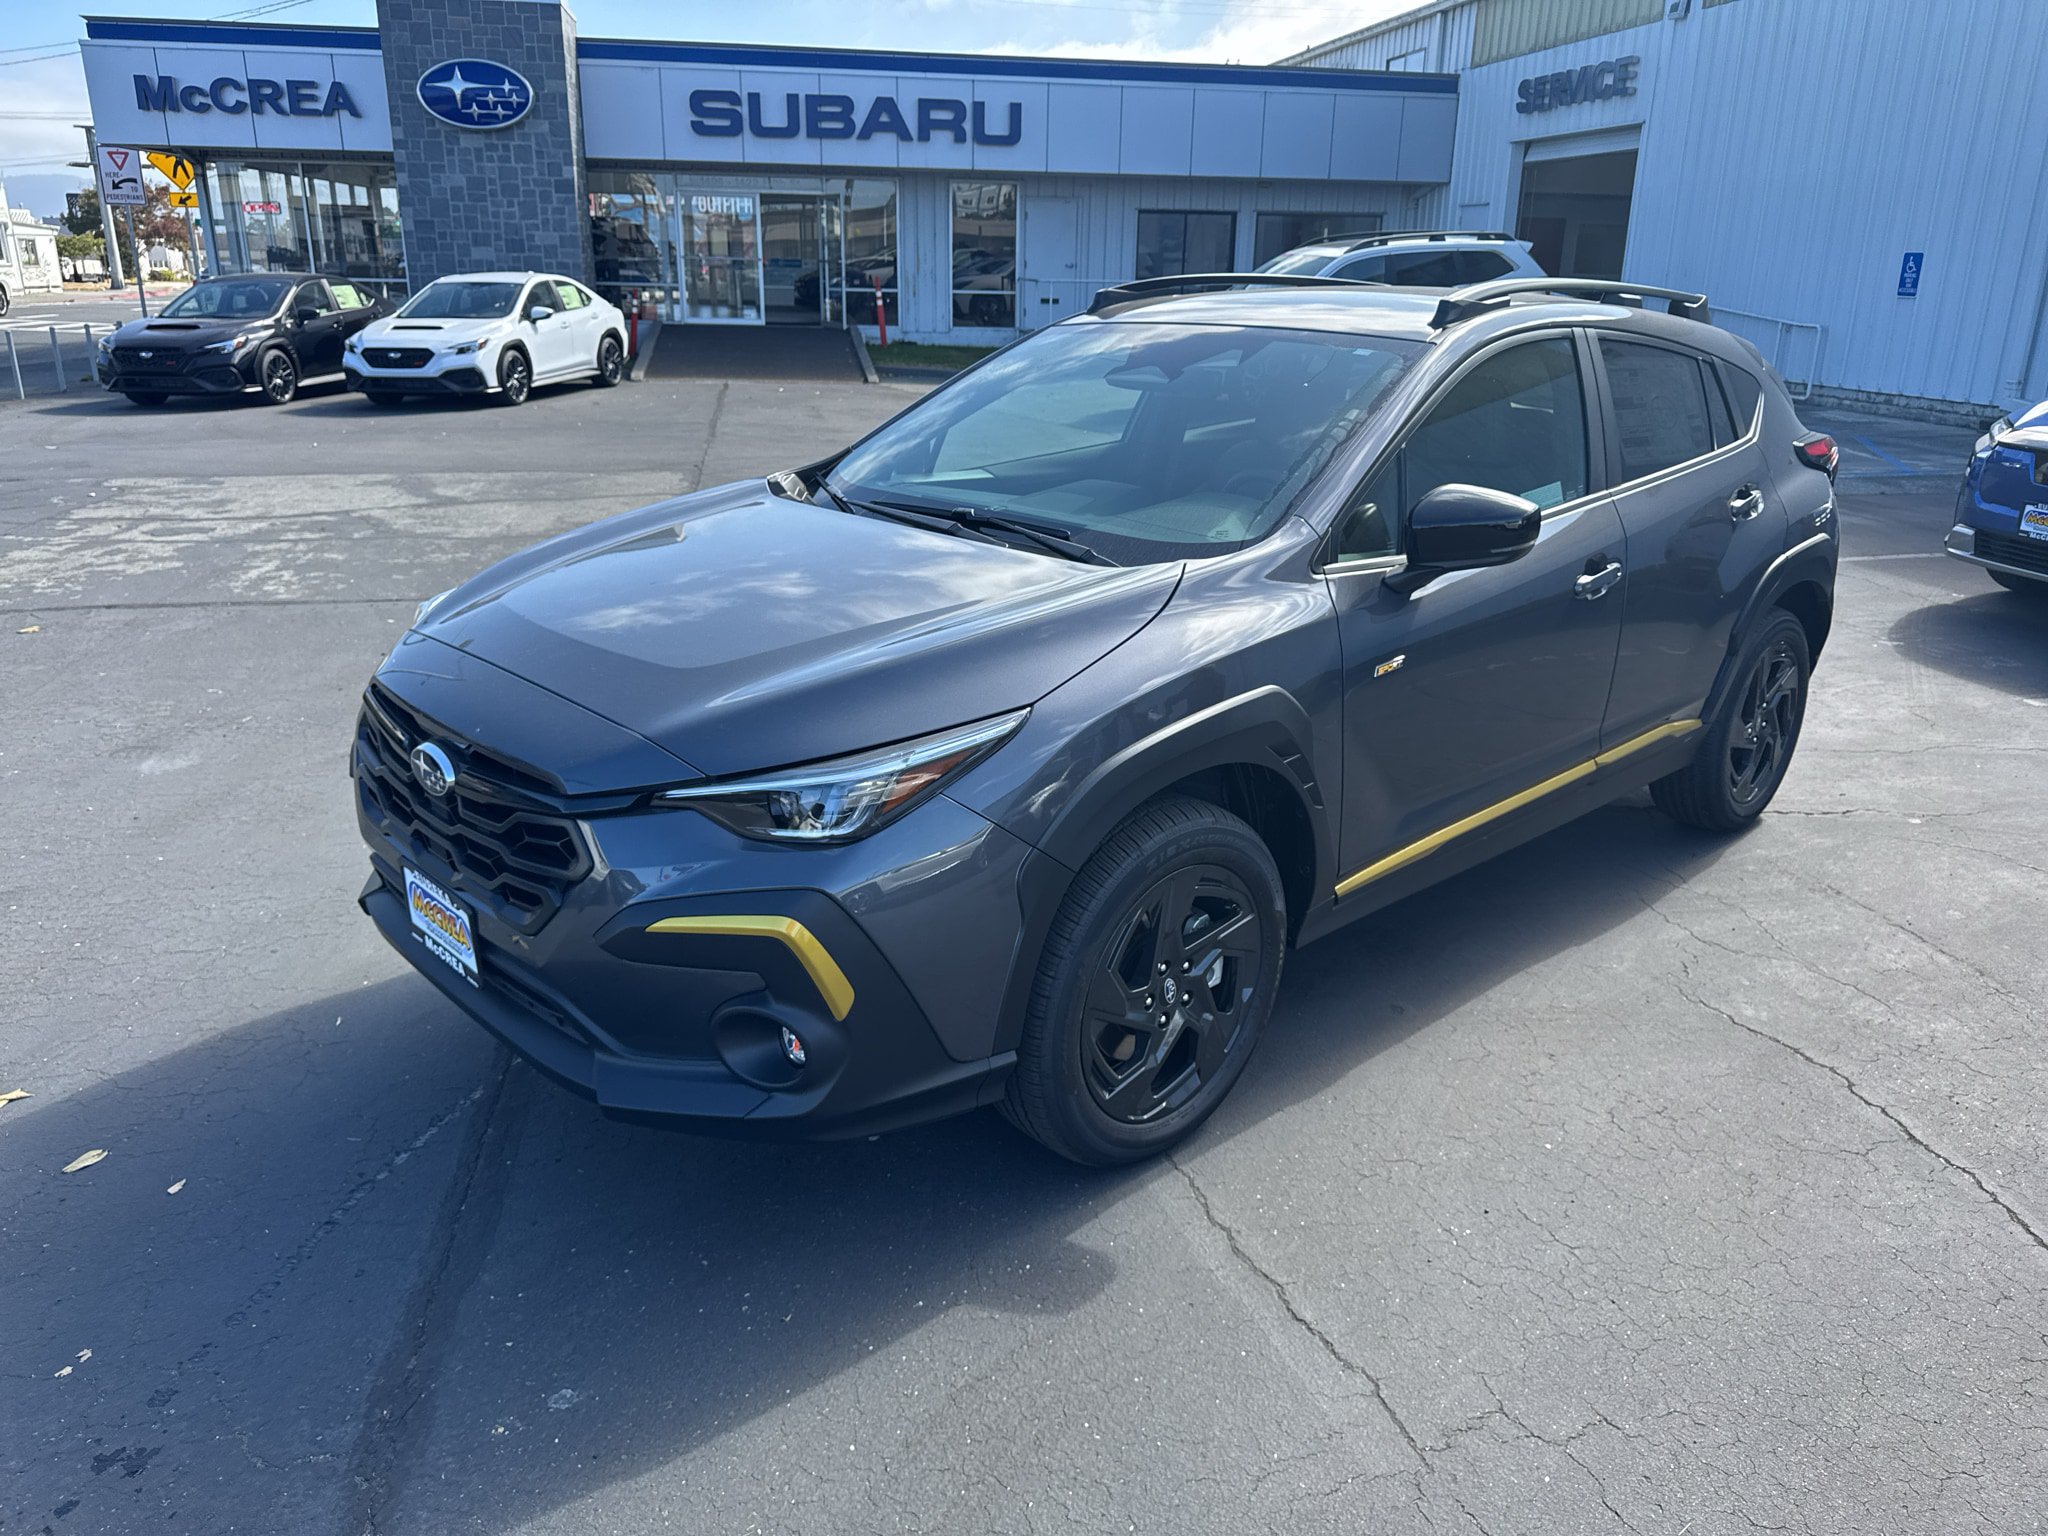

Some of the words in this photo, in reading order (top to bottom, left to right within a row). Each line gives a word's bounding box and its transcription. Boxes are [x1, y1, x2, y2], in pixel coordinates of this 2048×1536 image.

[133, 74, 362, 118] McCREA
[1516, 55, 1640, 113] SERVICE
[689, 89, 1022, 146] SUBARU
[106, 193, 144, 201] PEDESTRIANS
[424, 934, 466, 977] McCREA
